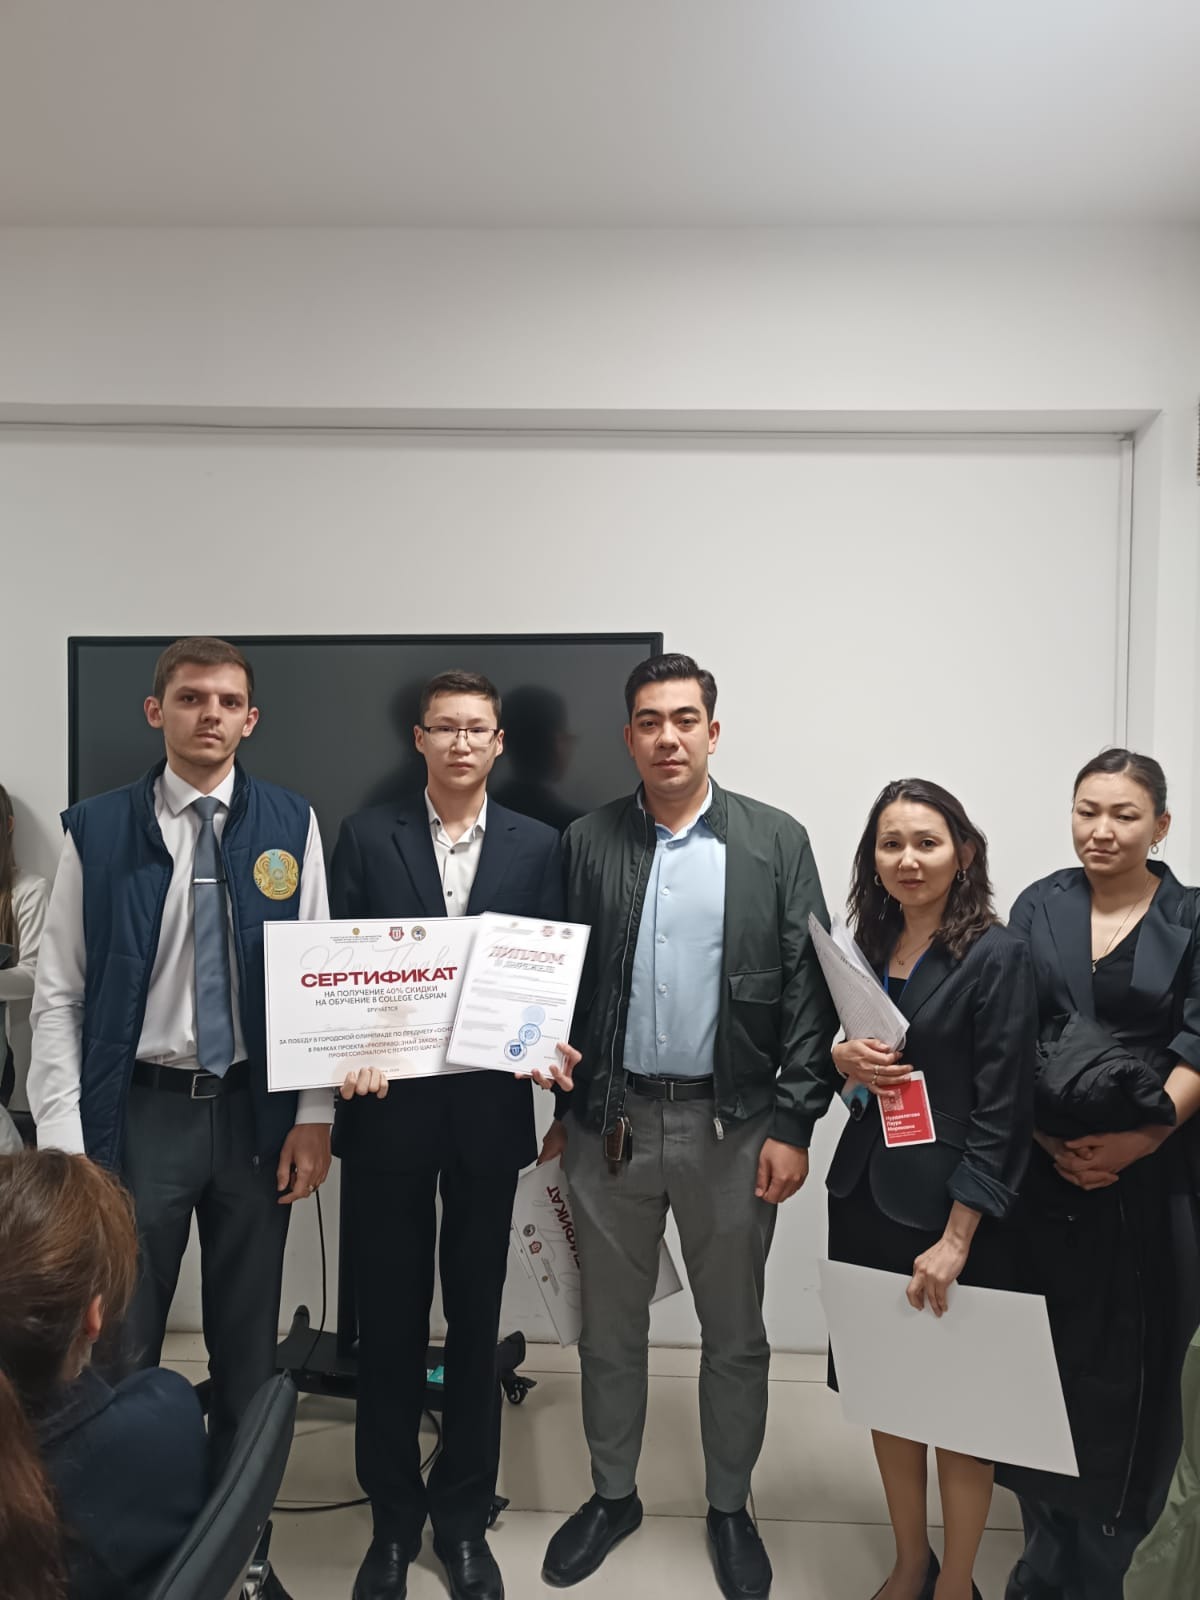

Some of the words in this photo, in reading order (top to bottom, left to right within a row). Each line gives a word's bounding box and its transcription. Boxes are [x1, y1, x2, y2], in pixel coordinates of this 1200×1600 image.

[301, 967, 457, 988] СЕРТИФИКАТ
[337, 988, 385, 997] ПОЛУЧЕНИЕ
[386, 987, 403, 995] 40%
[405, 985, 438, 994] СКИДКИ
[328, 997, 371, 1006] ОБУЧЕНИЕ
[379, 994, 412, 1003] COLLEGE
[413, 991, 447, 1001] CASPIAN
[318, 1033, 354, 1042] ГОРОДСКОЙ
[355, 1031, 392, 1040] ОЛИМПИАДЕ
[402, 1028, 433, 1037] ПРЕДМЕТУ
[328, 1049, 386, 1057] ПРОФЕССИОНАЛОМ
